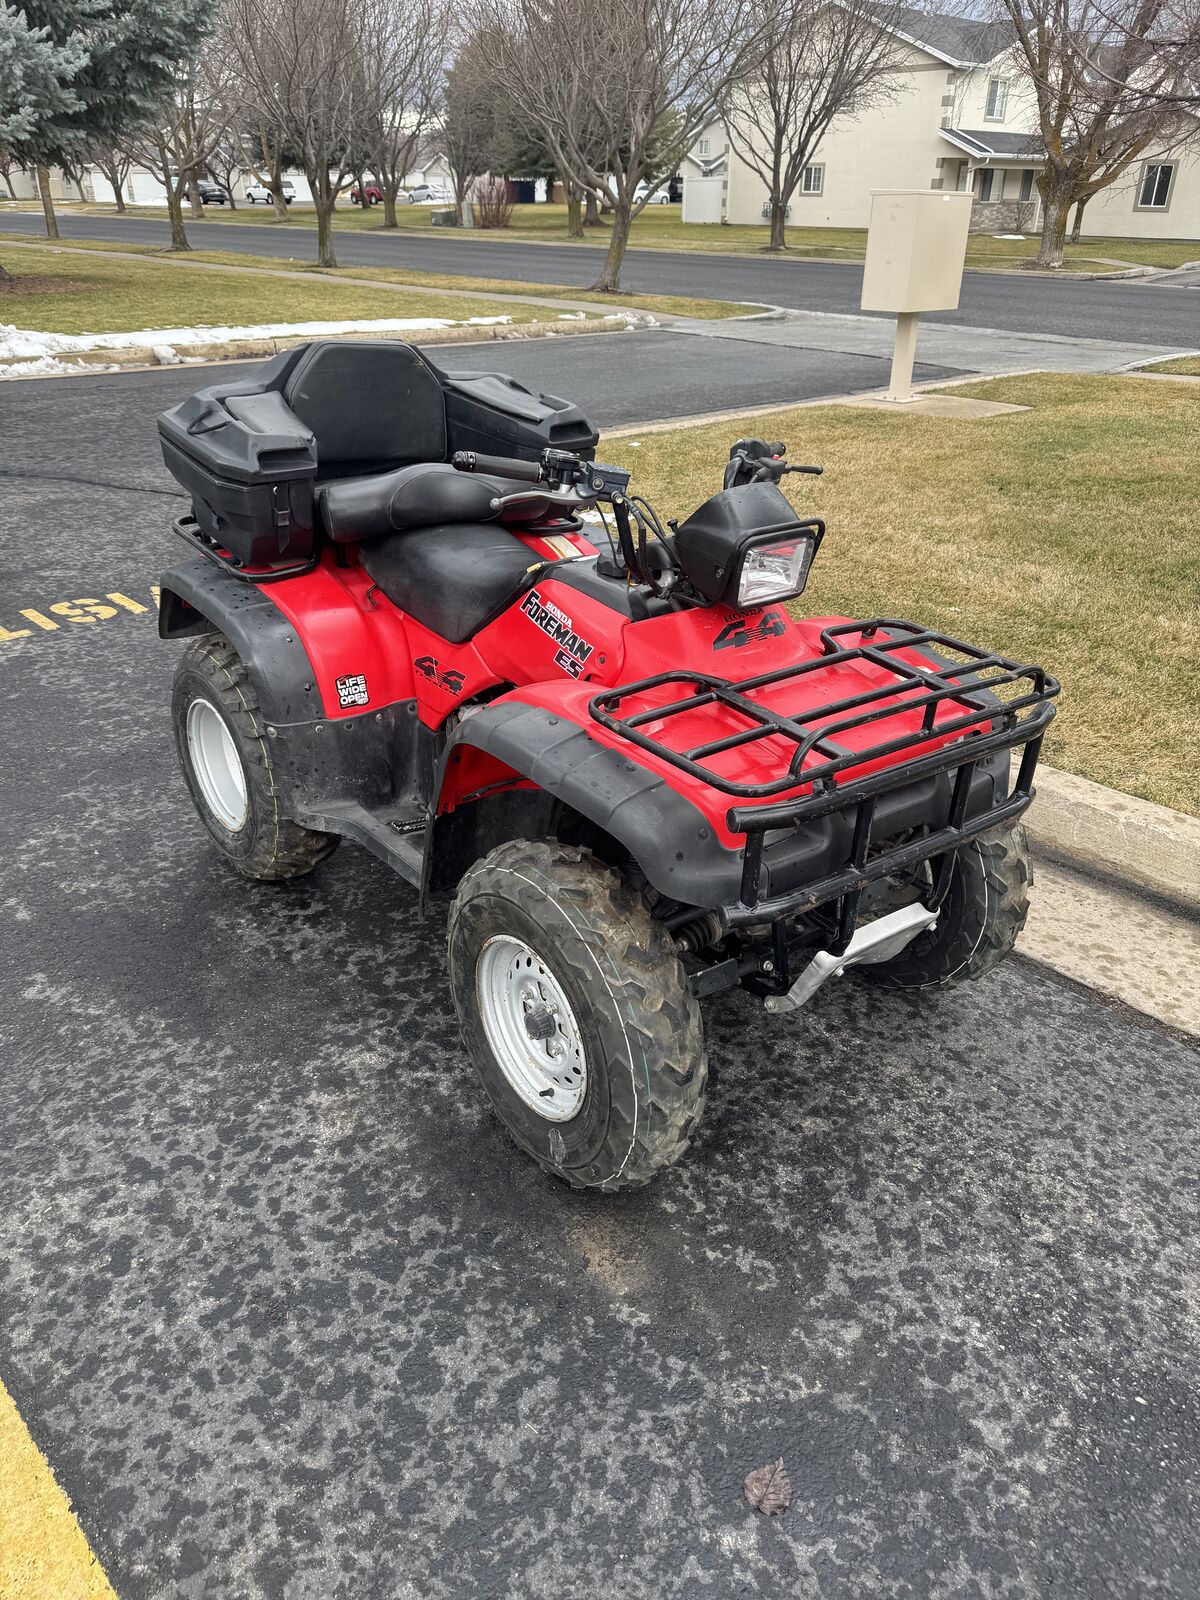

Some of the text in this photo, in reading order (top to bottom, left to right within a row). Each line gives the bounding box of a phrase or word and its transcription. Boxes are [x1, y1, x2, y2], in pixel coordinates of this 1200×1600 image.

[545, 601, 572, 628] HONDA
[723, 607, 764, 623] HONDA
[520, 588, 594, 663] FOREMAN
[553, 648, 584, 680] ES
[336, 675, 366, 689] LIFE
[338, 683, 367, 697] WIDE
[340, 691, 368, 705] OPEN
